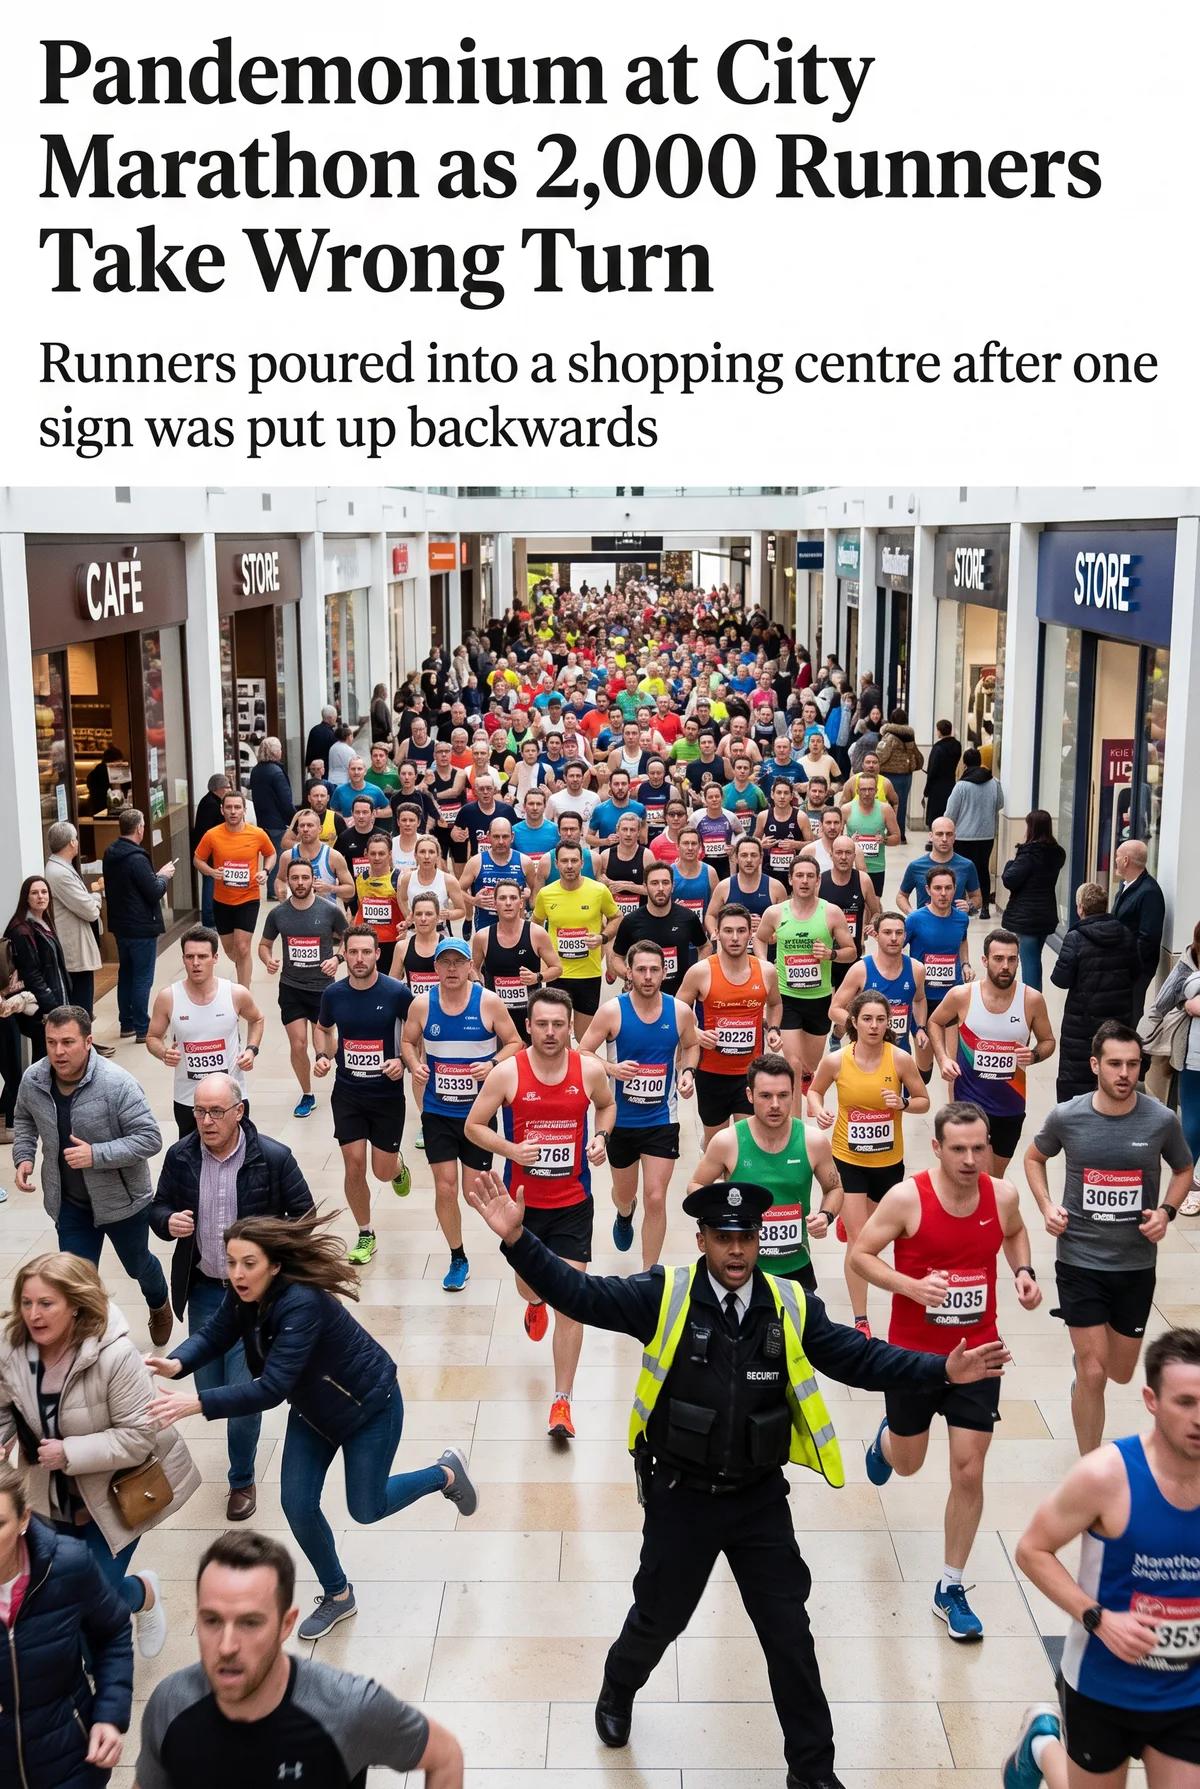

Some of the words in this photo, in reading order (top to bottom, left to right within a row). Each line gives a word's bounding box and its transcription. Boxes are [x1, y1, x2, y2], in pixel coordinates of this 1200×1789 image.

[241, 551, 280, 596] STORE
[954, 547, 985, 590] STORE
[86, 546, 144, 621] CAFÉ
[1074, 551, 1131, 612] STORE
[225, 870, 249, 879] 21032
[364, 906, 389, 916] 10063
[559, 939, 586, 949] 20635
[718, 1031, 753, 1043] 20226
[347, 1053, 380, 1066] 20229
[976, 1055, 1014, 1068] 33268
[438, 1077, 473, 1090] 25339
[625, 1079, 663, 1092] 23100
[850, 1124, 890, 1139] 33360
[1086, 1189, 1139, 1206] 30667
[931, 1290, 983, 1309] 3035
